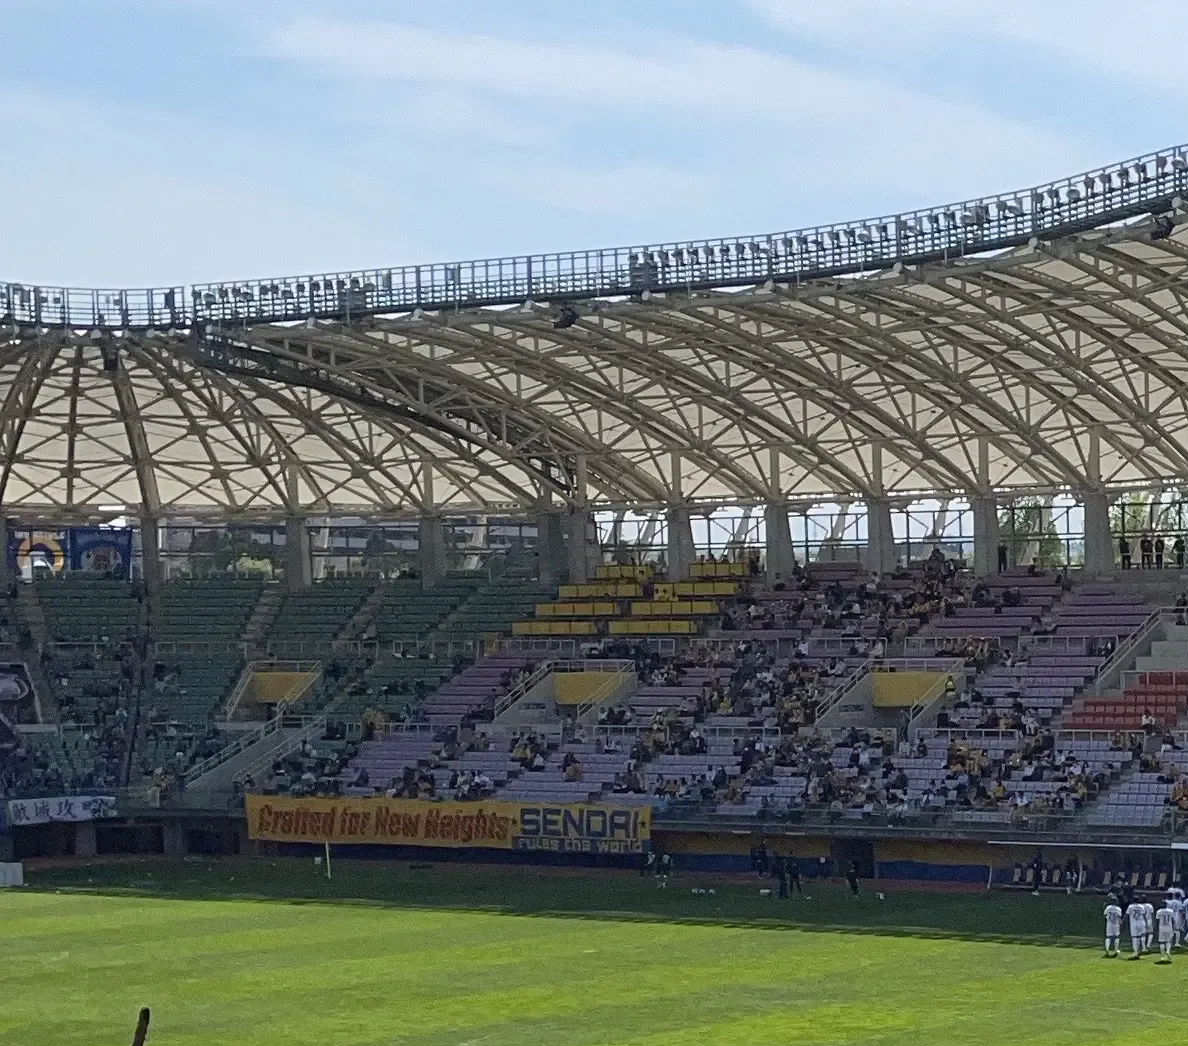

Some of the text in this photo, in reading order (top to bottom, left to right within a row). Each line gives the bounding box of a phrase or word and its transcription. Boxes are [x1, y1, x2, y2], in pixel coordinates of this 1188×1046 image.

[340, 806, 371, 836] for
[374, 805, 421, 838] New
[520, 808, 640, 839] SENDAI
